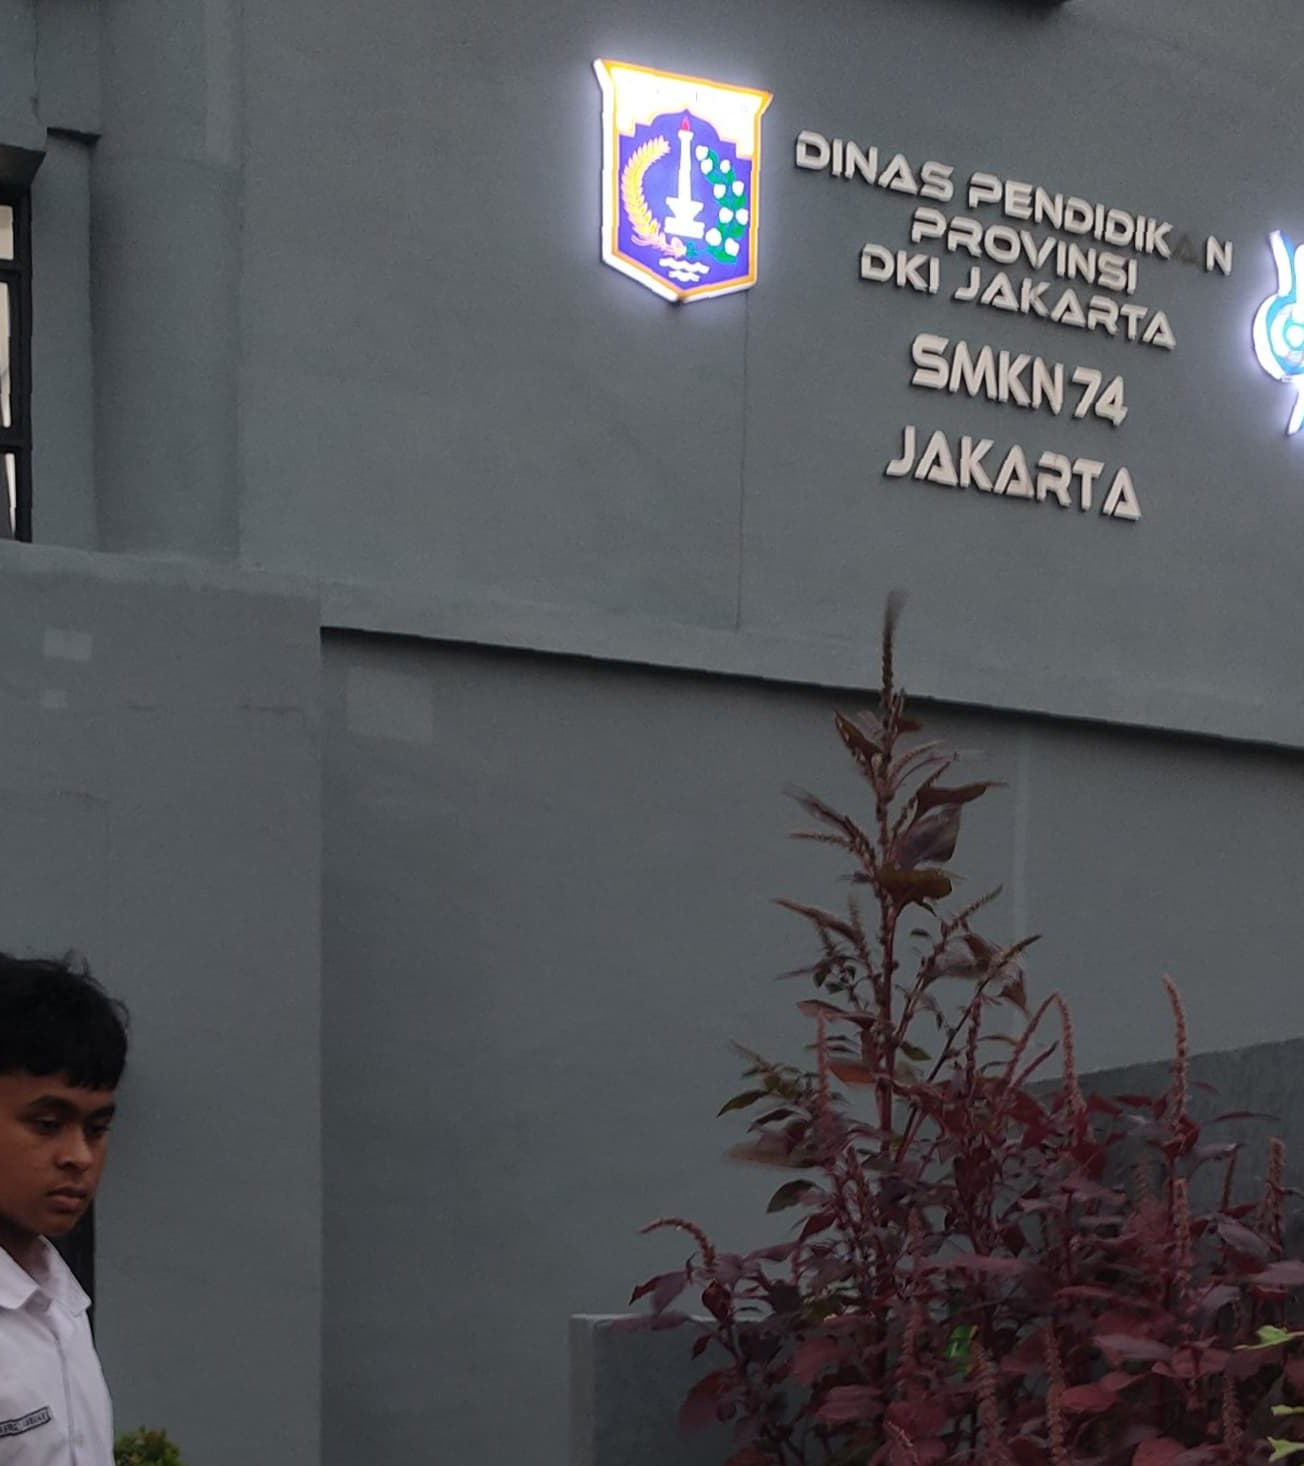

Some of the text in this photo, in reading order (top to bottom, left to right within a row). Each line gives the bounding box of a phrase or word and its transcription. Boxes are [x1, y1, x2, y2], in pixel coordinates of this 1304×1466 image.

[796, 131, 1232, 276] DINAS PENDIDIKN
[912, 208, 1137, 294] PROVINSI
[861, 244, 1176, 349] DKI JAKARTA
[911, 334, 1127, 426] SMKN 74
[886, 425, 1141, 520] JAKARTA
